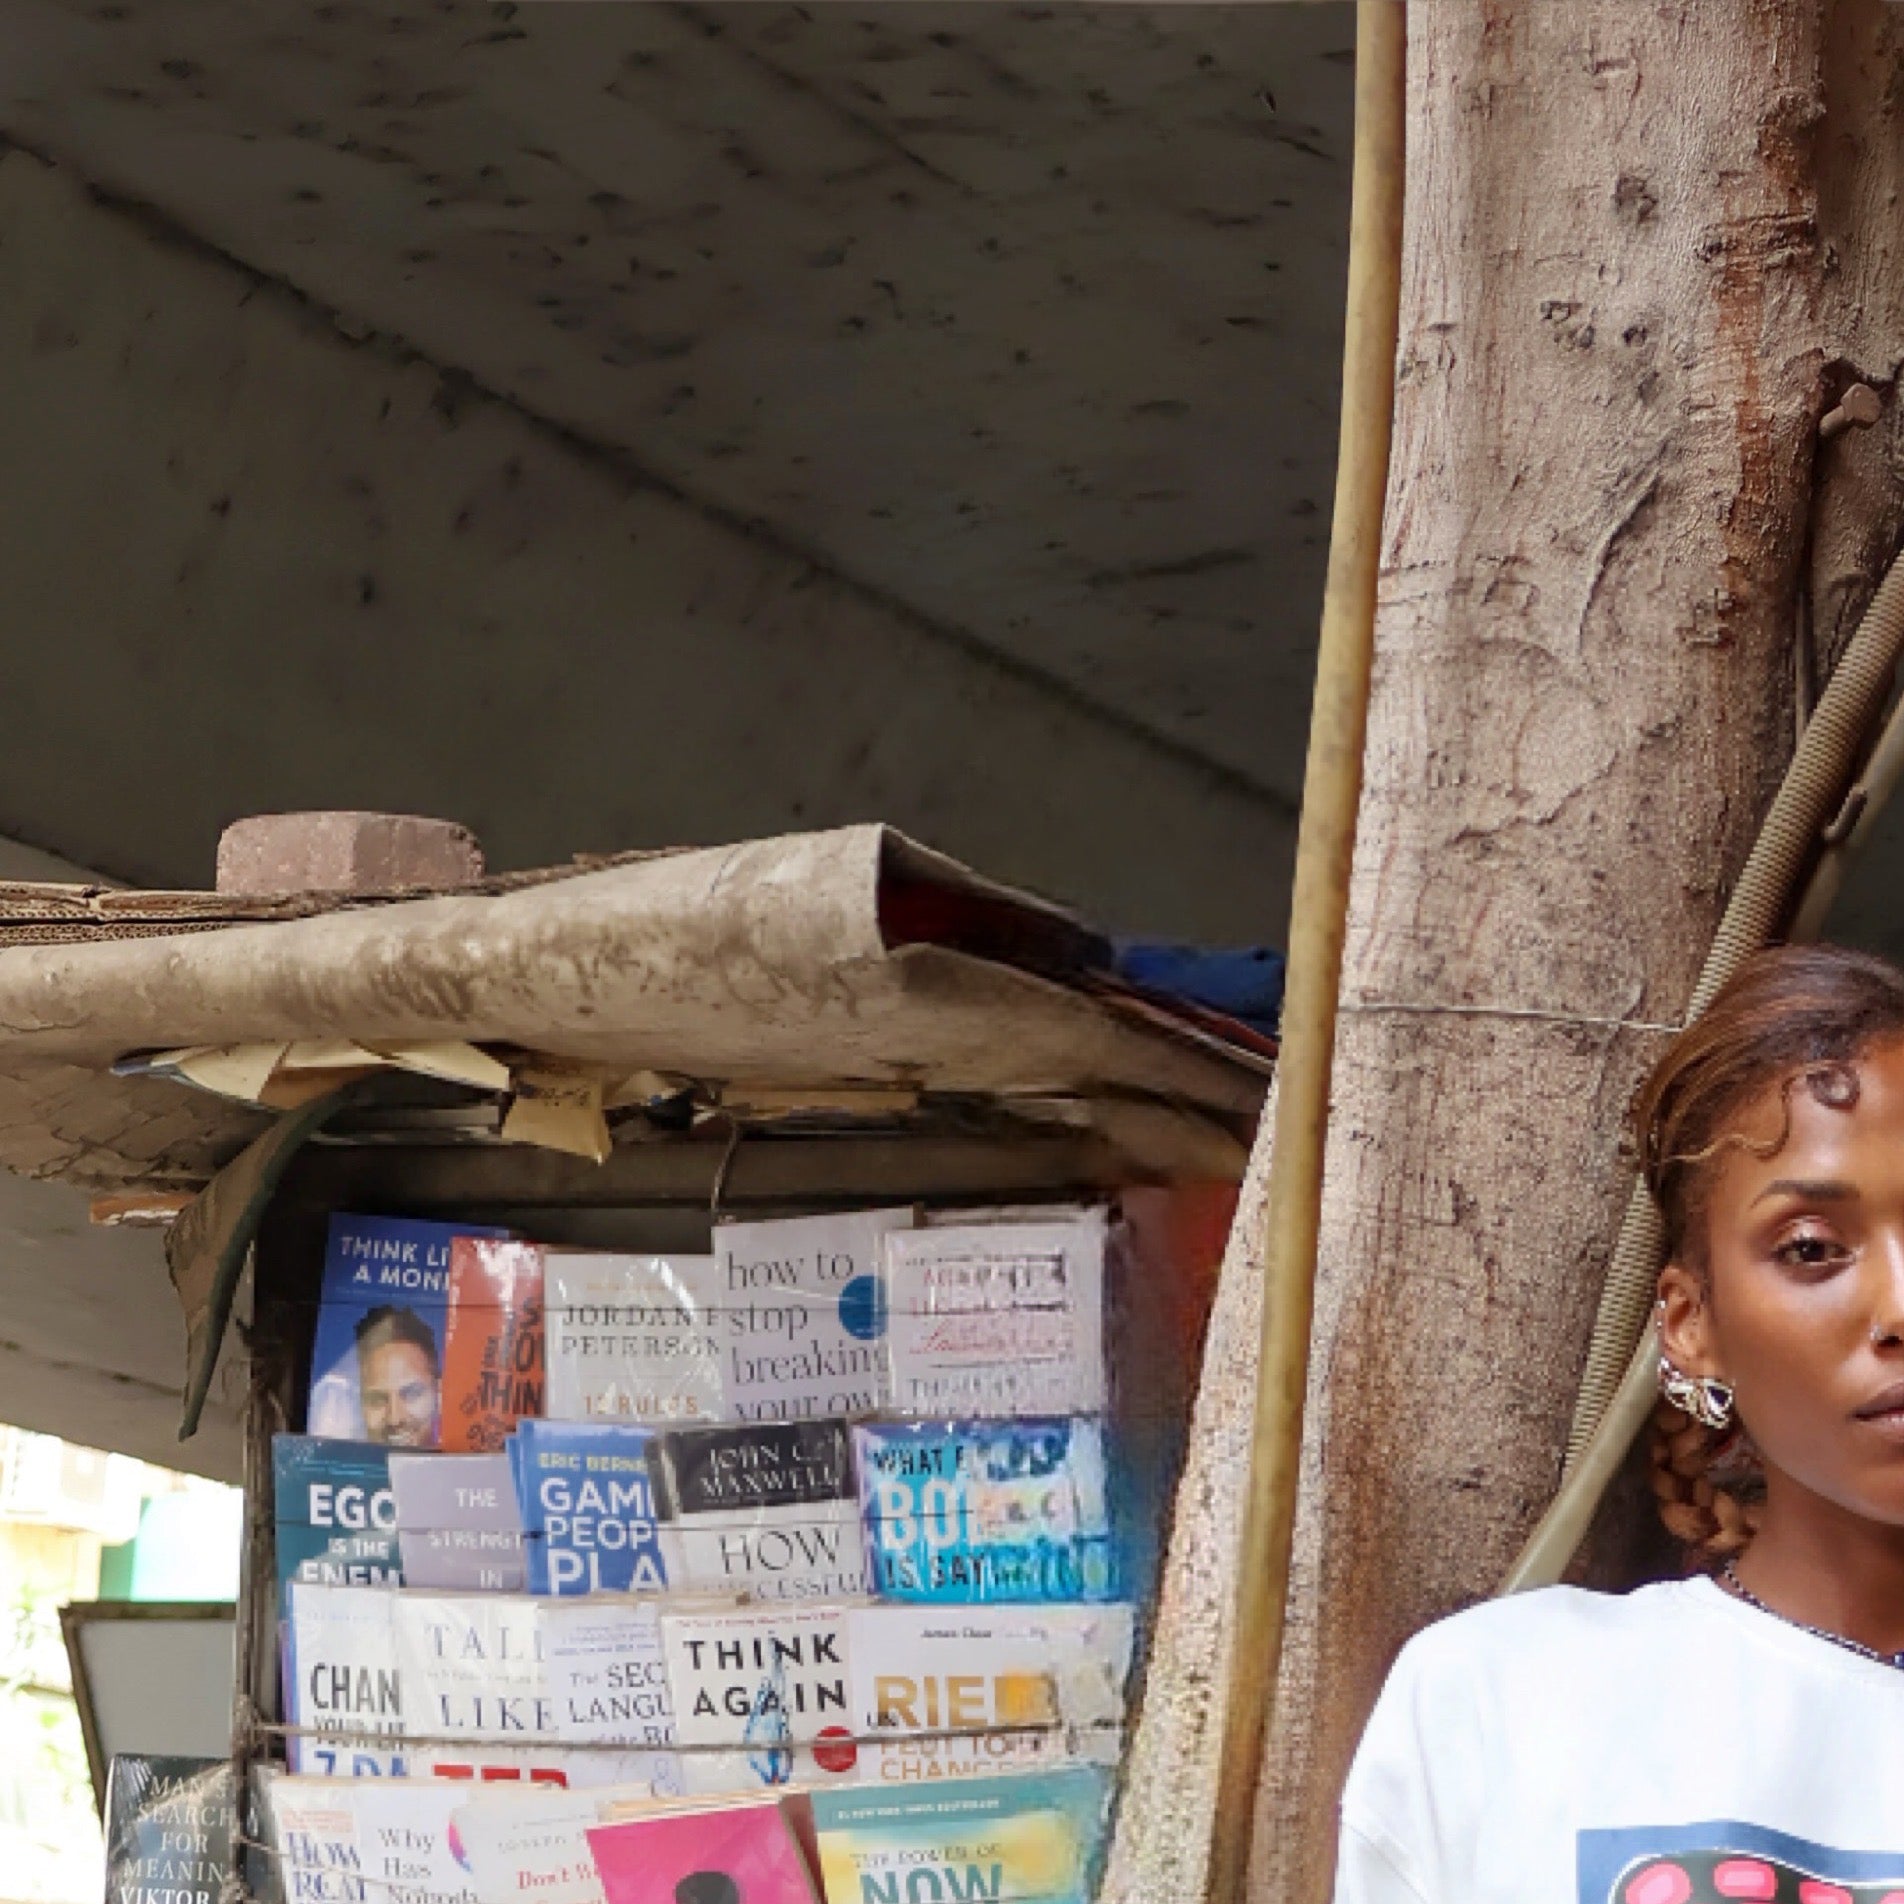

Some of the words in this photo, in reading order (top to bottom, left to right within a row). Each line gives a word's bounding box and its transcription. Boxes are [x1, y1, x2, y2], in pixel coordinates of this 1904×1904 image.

[340, 1236, 417, 1264] THINK
[727, 1251, 803, 1291] how
[816, 1249, 854, 1281] to
[562, 1304, 692, 1328] JORDAN
[728, 1303, 809, 1341] stop
[561, 1336, 721, 1357] PETERSON
[537, 1451, 579, 1470] ERIC
[709, 1442, 779, 1472] JOHN
[875, 1445, 944, 1477] WHAT
[309, 1483, 398, 1528] EGO
[455, 1488, 497, 1509] THE
[540, 1477, 656, 1518] GAM
[352, 1538, 390, 1561] THE
[718, 1526, 840, 1576] HOW
[682, 1632, 843, 1672] THINK
[440, 1693, 559, 1734] LIKE
[692, 1679, 848, 1719] AGAIN
[161, 1831, 209, 1853] FOR
[379, 1827, 436, 1854] Why
[383, 1856, 432, 1879] Has
